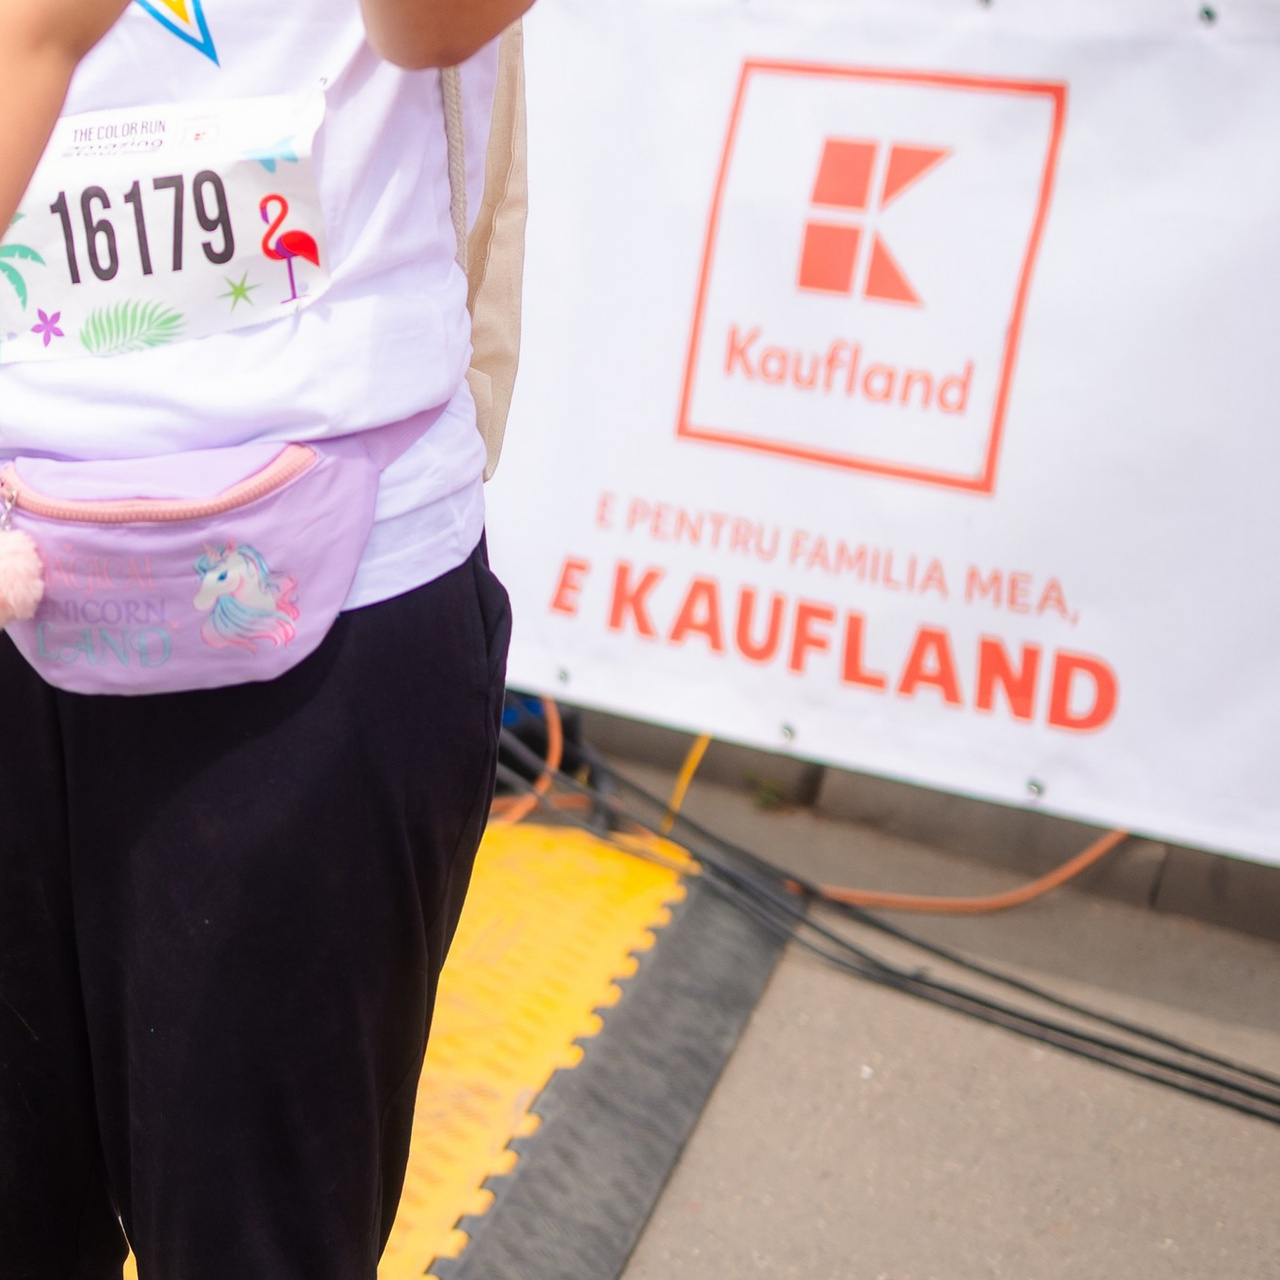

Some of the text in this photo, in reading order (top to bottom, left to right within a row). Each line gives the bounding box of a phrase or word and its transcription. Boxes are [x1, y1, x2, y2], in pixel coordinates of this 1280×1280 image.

[73, 120, 166, 143] THE COLOR RUN
[50, 170, 235, 284] 16179
[724, 324, 974, 415] Kaufland
[596, 492, 1080, 627] E PENTRU FAMILIA MEA,
[36, 621, 173, 668] LAND
[549, 556, 1120, 733] E KAUFLAND
